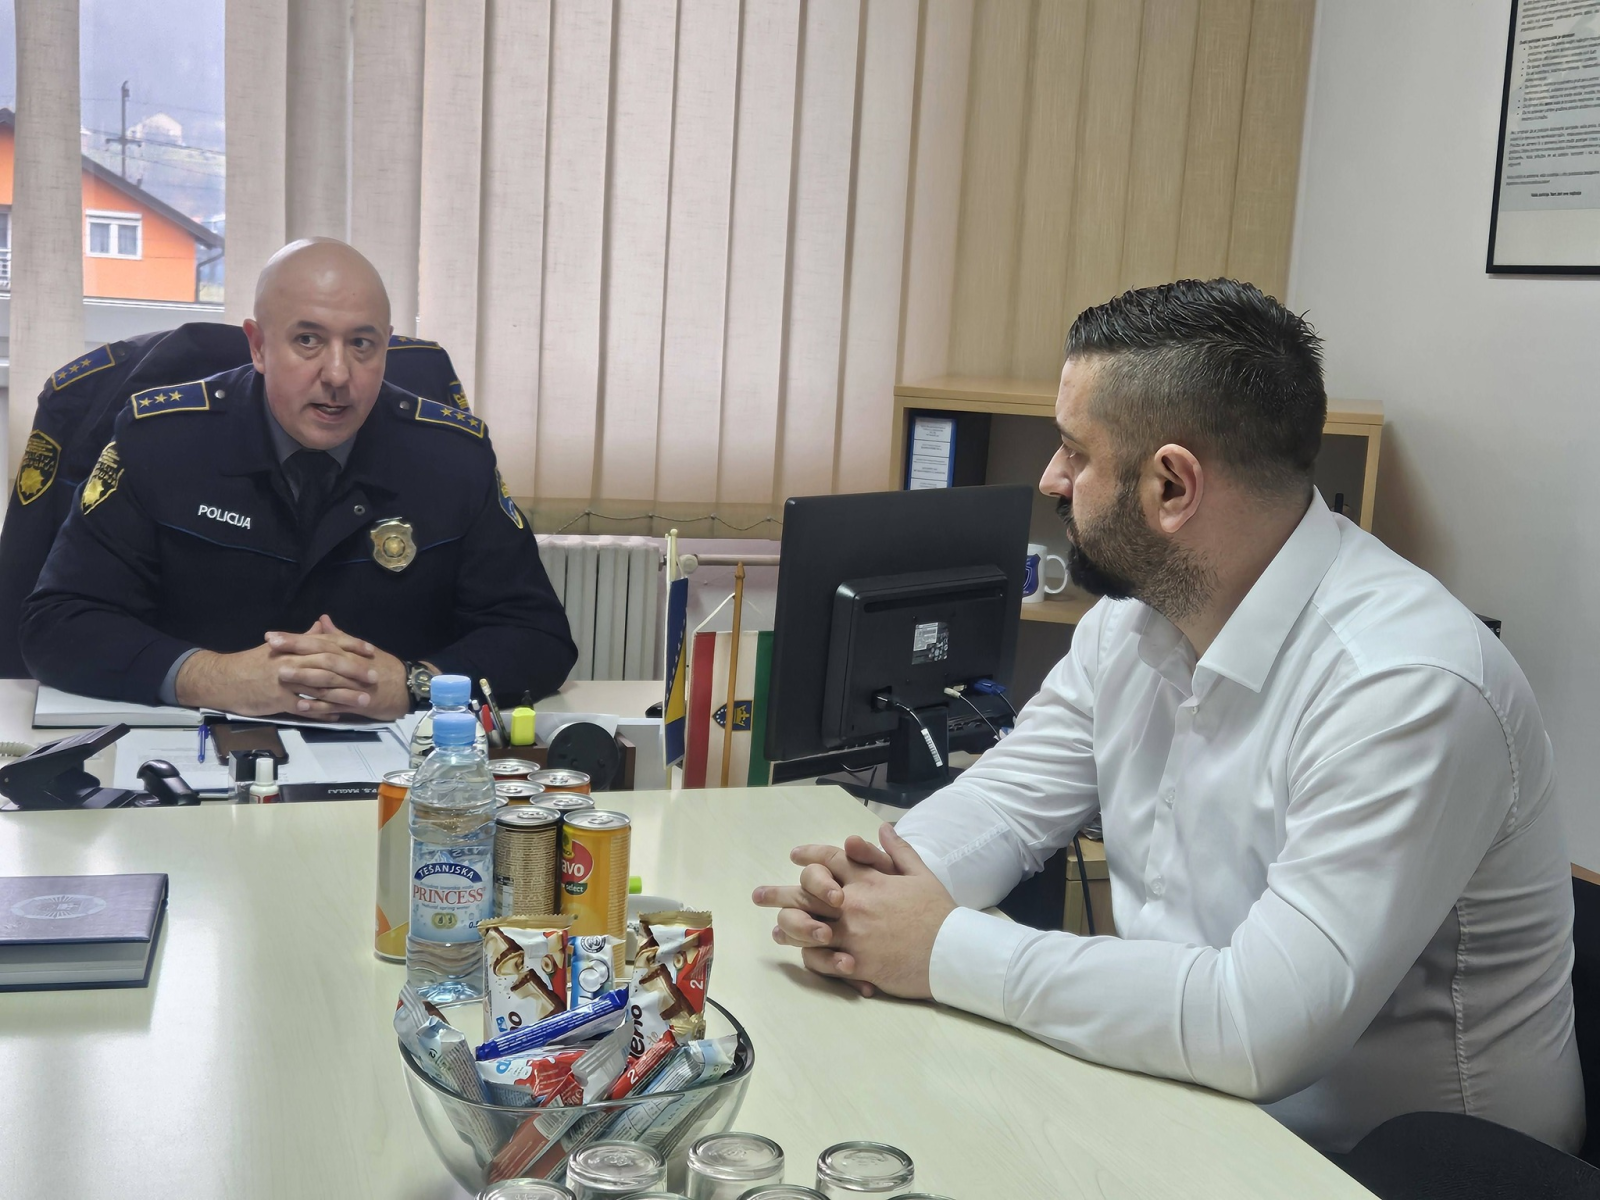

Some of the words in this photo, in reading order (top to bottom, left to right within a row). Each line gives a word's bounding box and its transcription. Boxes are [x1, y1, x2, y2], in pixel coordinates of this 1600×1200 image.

[197, 504, 251, 530] POLICIJA
[418, 864, 475, 879] TEŠANJSKA
[561, 859, 585, 877] avo
[413, 885, 483, 905] PRINCESS
[690, 979, 704, 990] 2
[626, 1068, 640, 1085] 2
